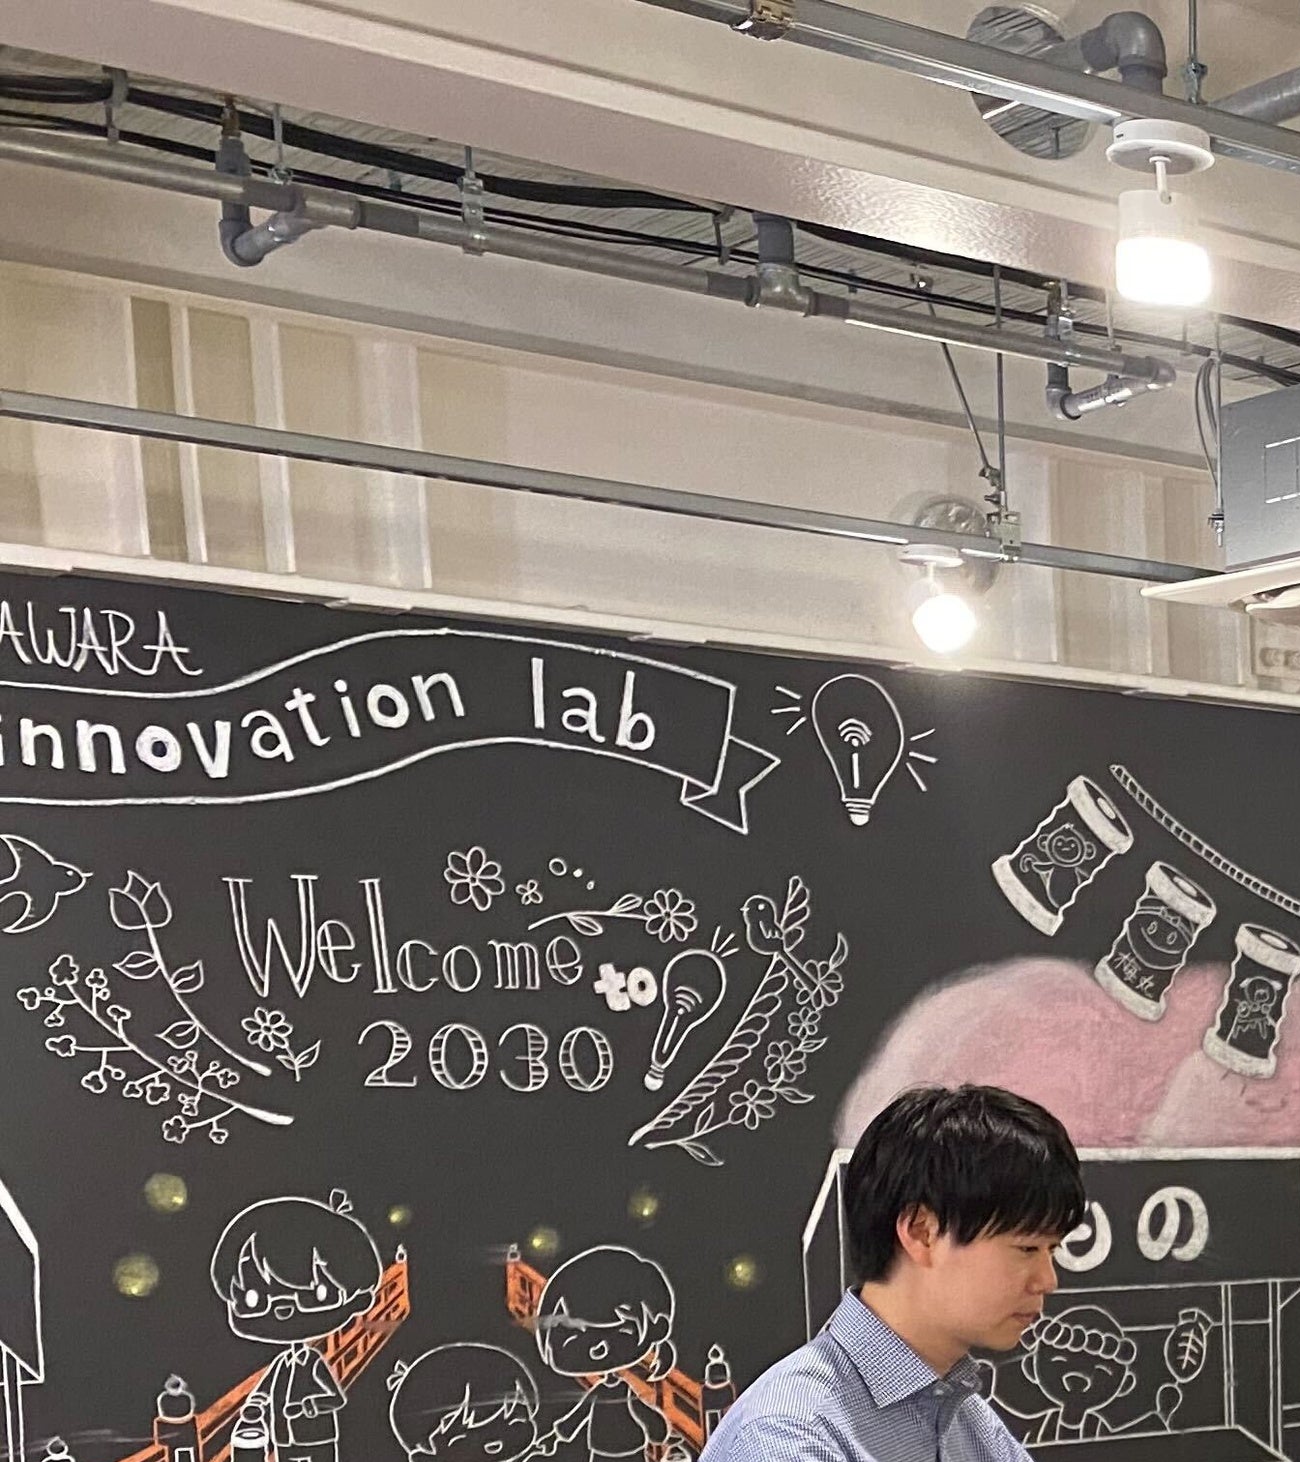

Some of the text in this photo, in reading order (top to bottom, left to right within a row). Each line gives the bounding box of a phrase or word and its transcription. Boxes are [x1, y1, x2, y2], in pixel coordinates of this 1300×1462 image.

[531, 657, 656, 751] lab
[222, 874, 583, 998] Welcome
[594, 963, 658, 1011] to
[358, 1020, 613, 1092] 2030
